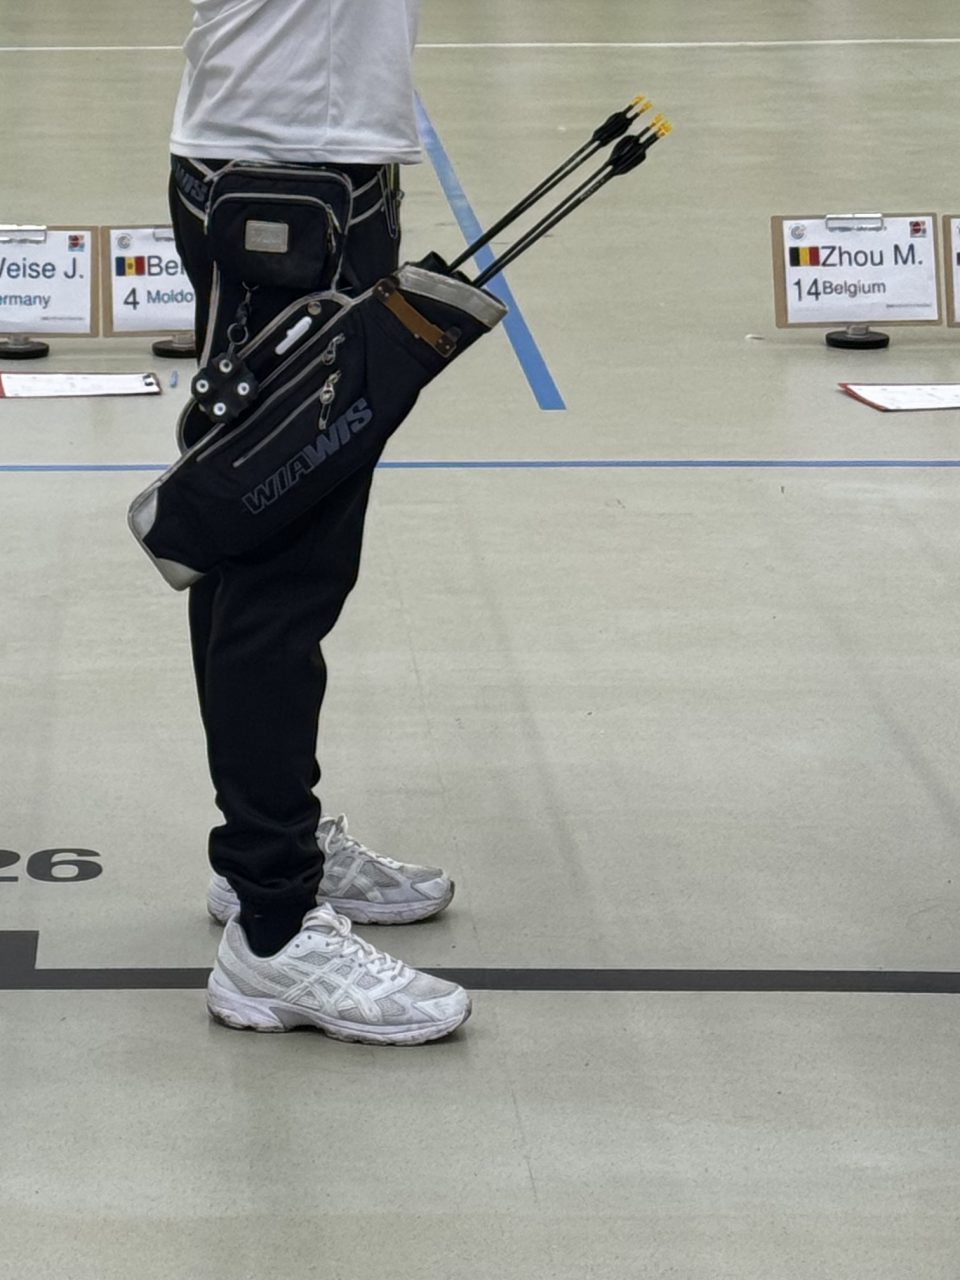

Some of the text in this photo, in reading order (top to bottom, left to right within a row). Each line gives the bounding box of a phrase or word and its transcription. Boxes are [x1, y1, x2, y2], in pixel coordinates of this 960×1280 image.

[820, 243, 923, 266] Zhou M.
[64, 258, 84, 279] J.
[123, 288, 194, 310] 4 Moldo
[793, 278, 886, 301] 14 Belgium
[241, 397, 373, 515] WIAWIS
